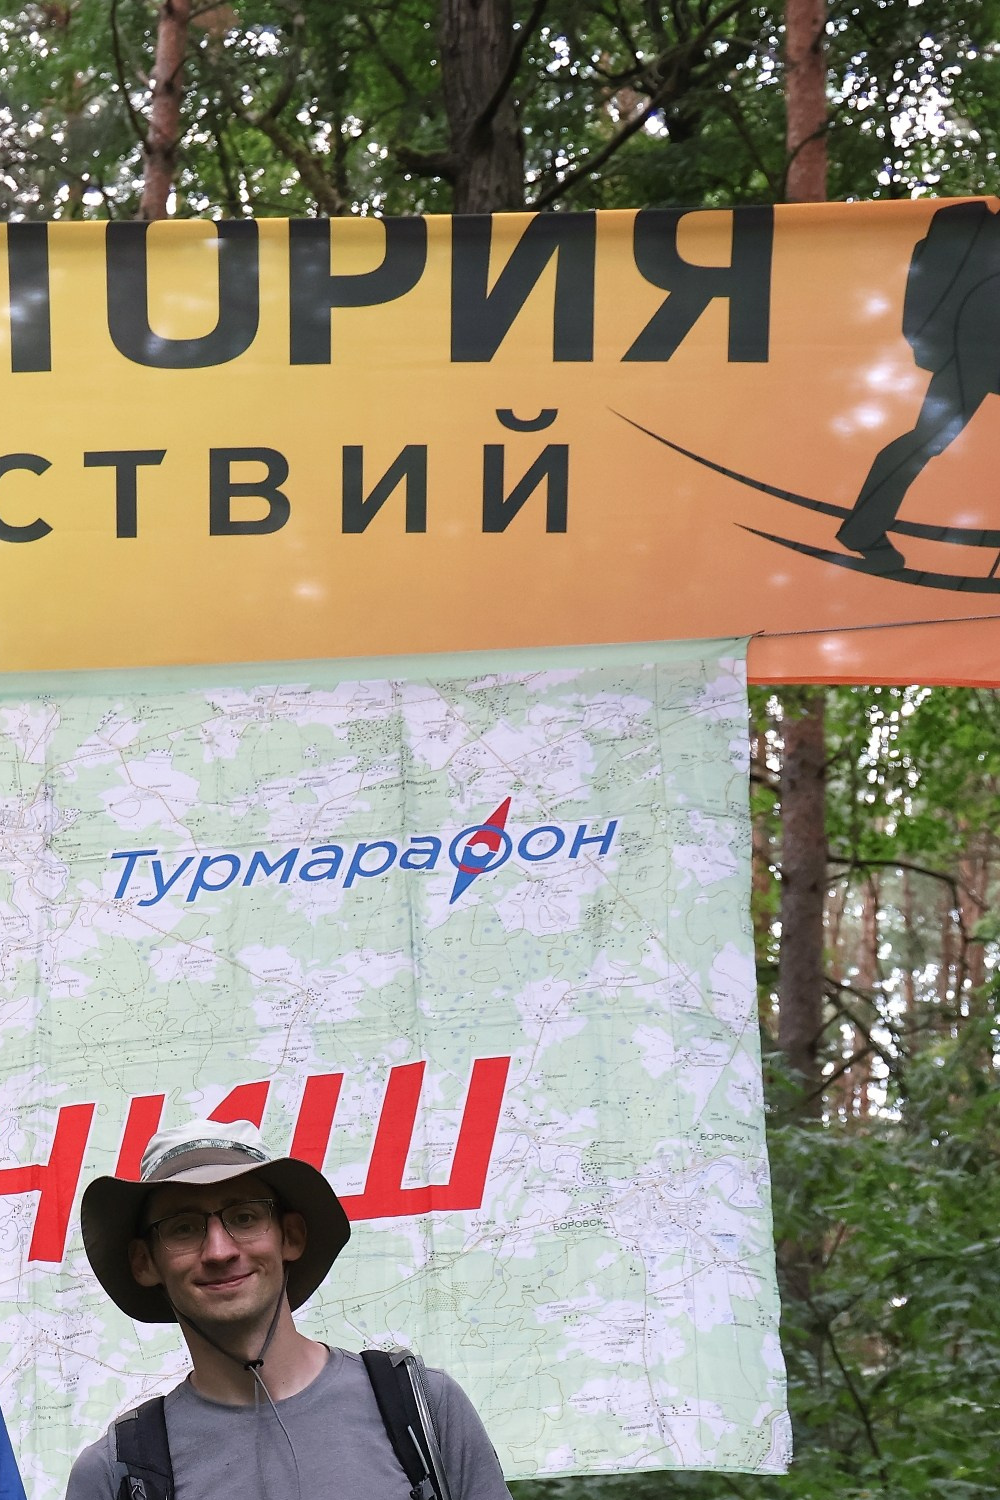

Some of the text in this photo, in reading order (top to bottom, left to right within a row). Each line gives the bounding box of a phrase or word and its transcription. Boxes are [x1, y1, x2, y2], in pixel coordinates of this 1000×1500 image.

[111, 797, 619, 907] Турмарафон
[700, 1133, 745, 1144] БОРОВСК
[553, 1218, 604, 1232] БОРОВСК
